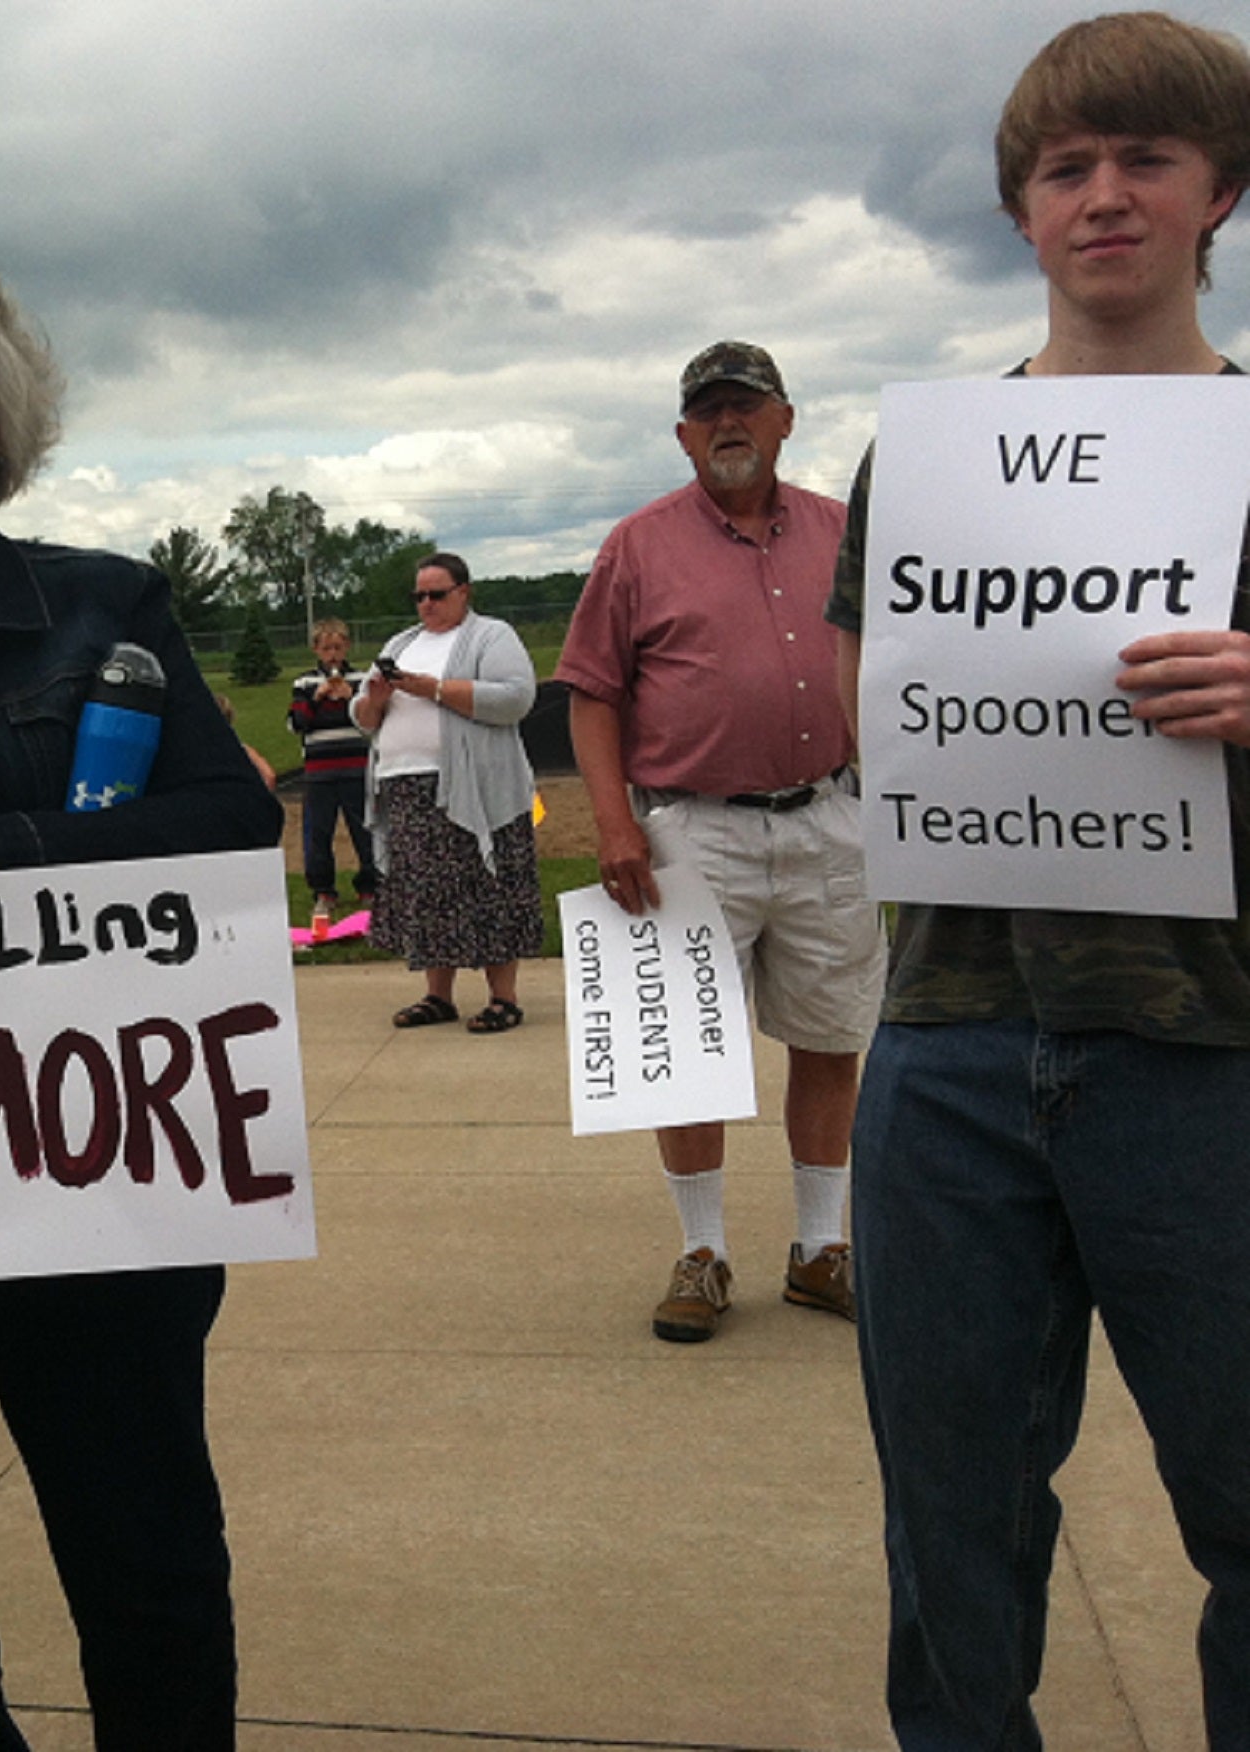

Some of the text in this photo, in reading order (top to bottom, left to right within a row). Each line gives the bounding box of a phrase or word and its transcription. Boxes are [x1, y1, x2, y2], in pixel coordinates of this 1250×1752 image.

[997, 433, 1106, 484] WE
[888, 554, 1195, 630] Support
[880, 792, 1193, 852] Teachers!
[575, 919, 618, 1101] come FIRST!
[629, 919, 672, 1083] STUDENTS
[685, 924, 726, 1057] Spooner
